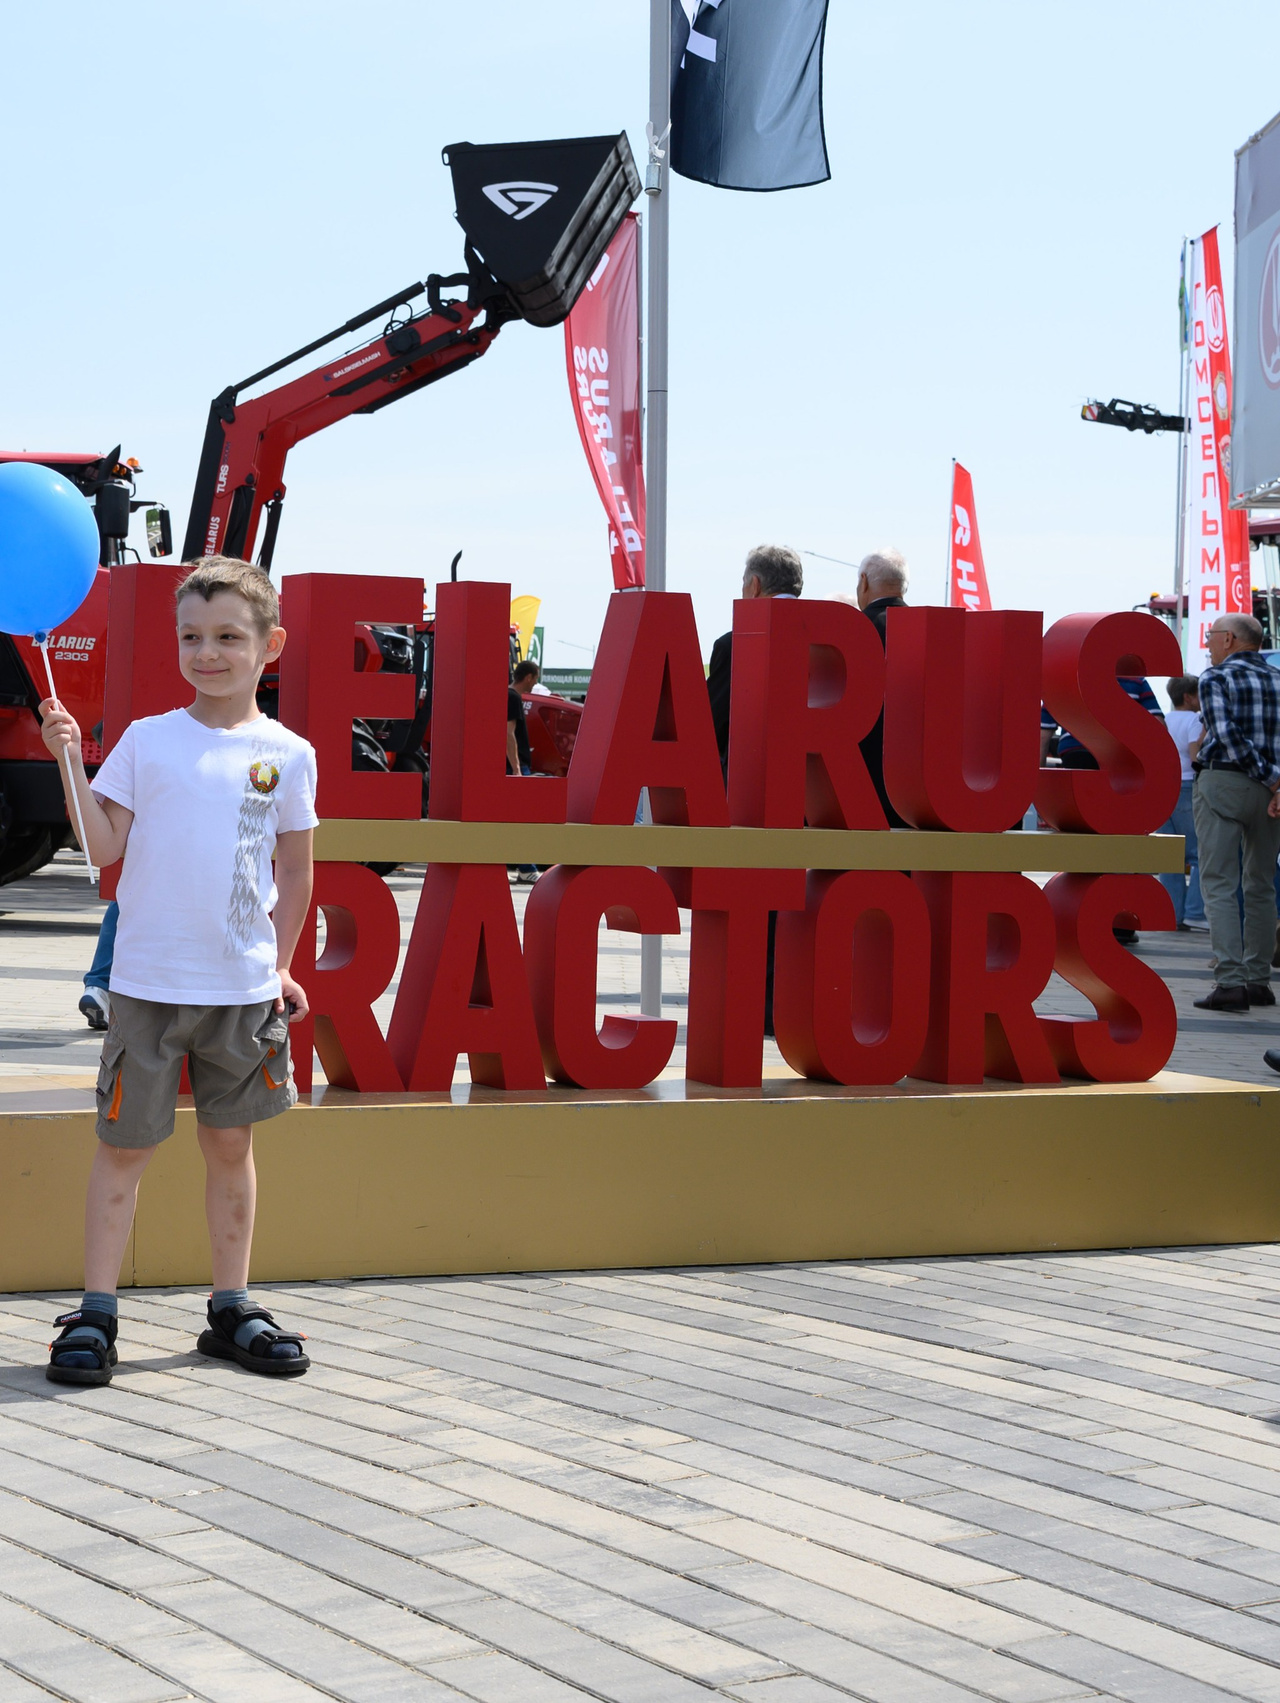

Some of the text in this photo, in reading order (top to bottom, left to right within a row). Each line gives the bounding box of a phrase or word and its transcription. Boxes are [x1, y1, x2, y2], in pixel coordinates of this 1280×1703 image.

[204, 516, 221, 561] BELARUS
[31, 634, 97, 651] BLARUS
[54, 651, 90, 662] 2303
[102, 564, 1183, 835] ELARUS
[99, 860, 1178, 1094] RACTORS
